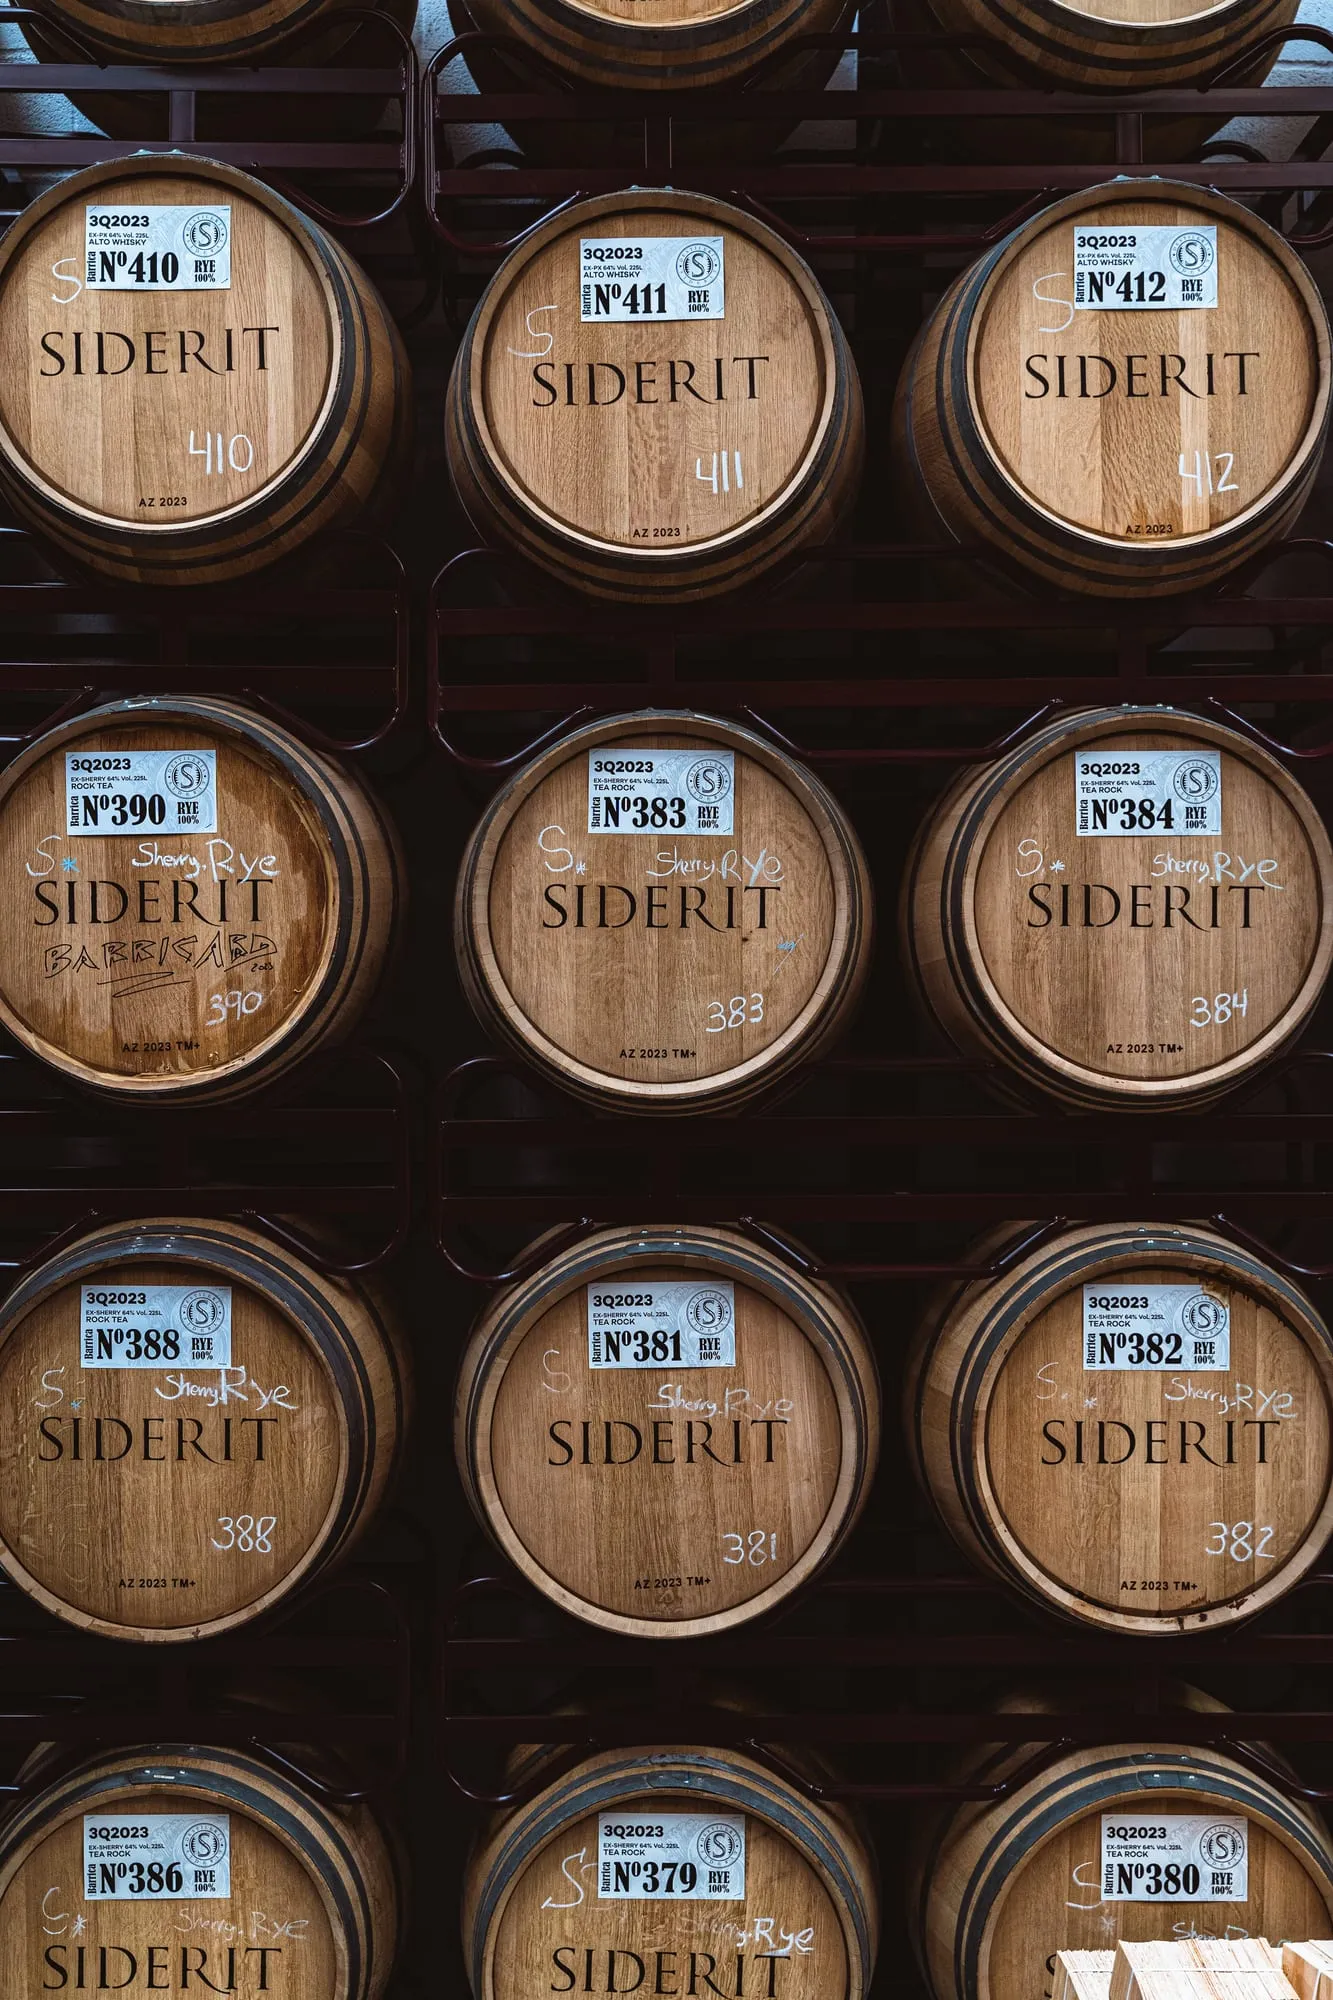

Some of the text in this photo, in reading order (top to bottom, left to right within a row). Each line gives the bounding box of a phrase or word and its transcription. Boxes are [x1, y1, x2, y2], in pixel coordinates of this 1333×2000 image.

[89, 215, 150, 229] 3Q2023
[1077, 236, 1137, 250] 3Q2023
[583, 247, 643, 262] 3Q2023
[87, 251, 97, 282] Barrica
[194, 260, 216, 273] RYE
[194, 274, 216, 283] 100%
[583, 271, 604, 279] ALTO
[1075, 272, 1085, 303] Barrica
[1181, 279, 1203, 292] RYE
[582, 284, 591, 316] Barrica
[688, 290, 709, 303] RYE
[1181, 292, 1203, 301] 100%
[688, 304, 710, 313] 100%
[39, 326, 280, 377] SIDERIT
[532, 356, 770, 407] SIDERIT
[1024, 352, 1260, 399] SIDERIT
[188, 430, 254, 475] 410
[696, 450, 744, 494] 411
[1178, 450, 1240, 497] 412
[138, 497, 188, 507] AZ 2023
[632, 527, 681, 538] AZ 2023
[1125, 524, 1174, 534] AZ 2023
[70, 758, 131, 773] 3Q2023
[594, 760, 654, 775] 3Q2023
[1080, 763, 1140, 777] 3Q2023
[1080, 786, 1097, 794] TEA
[70, 795, 80, 827] Barrica
[177, 801, 199, 815] RYE
[591, 796, 601, 828] Barrica
[697, 806, 719, 820] RYE
[1079, 799, 1088, 830] Barrica
[1185, 806, 1207, 820] RYE
[177, 815, 200, 825] 100%
[697, 819, 719, 829] 100%
[1185, 820, 1207, 829] 100%
[34, 879, 273, 927] SIDERIT
[542, 883, 781, 933] SIDERIT
[1027, 883, 1265, 932] SIDERIT
[205, 990, 262, 1026] 390
[705, 993, 764, 1033] 383
[1190, 989, 1248, 1027] 384
[122, 1043, 139, 1052] AZ
[144, 1042, 172, 1051] 2023
[619, 1050, 636, 1059] AZ
[640, 1049, 668, 1059] 2023
[1106, 1044, 1123, 1053] AZ
[1127, 1044, 1154, 1053] 2023
[86, 1292, 147, 1307] 3Q2023
[593, 1294, 653, 1309] 3Q2023
[1088, 1296, 1149, 1311] 3Q2023
[1088, 1320, 1131, 1328] TEA ROCK
[84, 1328, 94, 1360] Barrica
[191, 1337, 214, 1351] RYE
[592, 1331, 601, 1363] Barrica
[699, 1337, 721, 1351] RYE
[1086, 1333, 1096, 1364] Barrica
[1194, 1341, 1216, 1355] RYE
[191, 1351, 214, 1360] 100%
[699, 1351, 721, 1361] 100%
[1194, 1355, 1215, 1365] 100%
[38, 1416, 278, 1465] SIDERIT
[548, 1420, 788, 1467] SIDERIT
[1041, 1420, 1281, 1468] SIDERIT
[211, 1515, 277, 1553] 388
[722, 1530, 776, 1566] 381
[1205, 1521, 1275, 1562] 382
[118, 1579, 135, 1588] AZ
[139, 1579, 167, 1588] 2023
[634, 1580, 650, 1590] AZ
[655, 1578, 682, 1587] 2023
[1120, 1581, 1137, 1591] AZ
[1141, 1581, 1169, 1590] 2023
[88, 1827, 149, 1841] 3Q2023
[603, 1825, 664, 1840] 3Q2023
[1106, 1827, 1167, 1841] 3Q2023
[87, 1863, 97, 1894] Barrica
[194, 1870, 216, 1883] RYE
[601, 1861, 611, 1892] Barrica
[708, 1871, 730, 1884] RYE
[1104, 1863, 1114, 1894] Barrica
[1211, 1872, 1233, 1885] RYE
[194, 1883, 216, 1892] 100%
[708, 1884, 730, 1893] 100%
[1211, 1886, 1233, 1895] 100%
[43, 1945, 282, 1995] SIDERIT
[551, 1947, 791, 2000] SIDERIT
